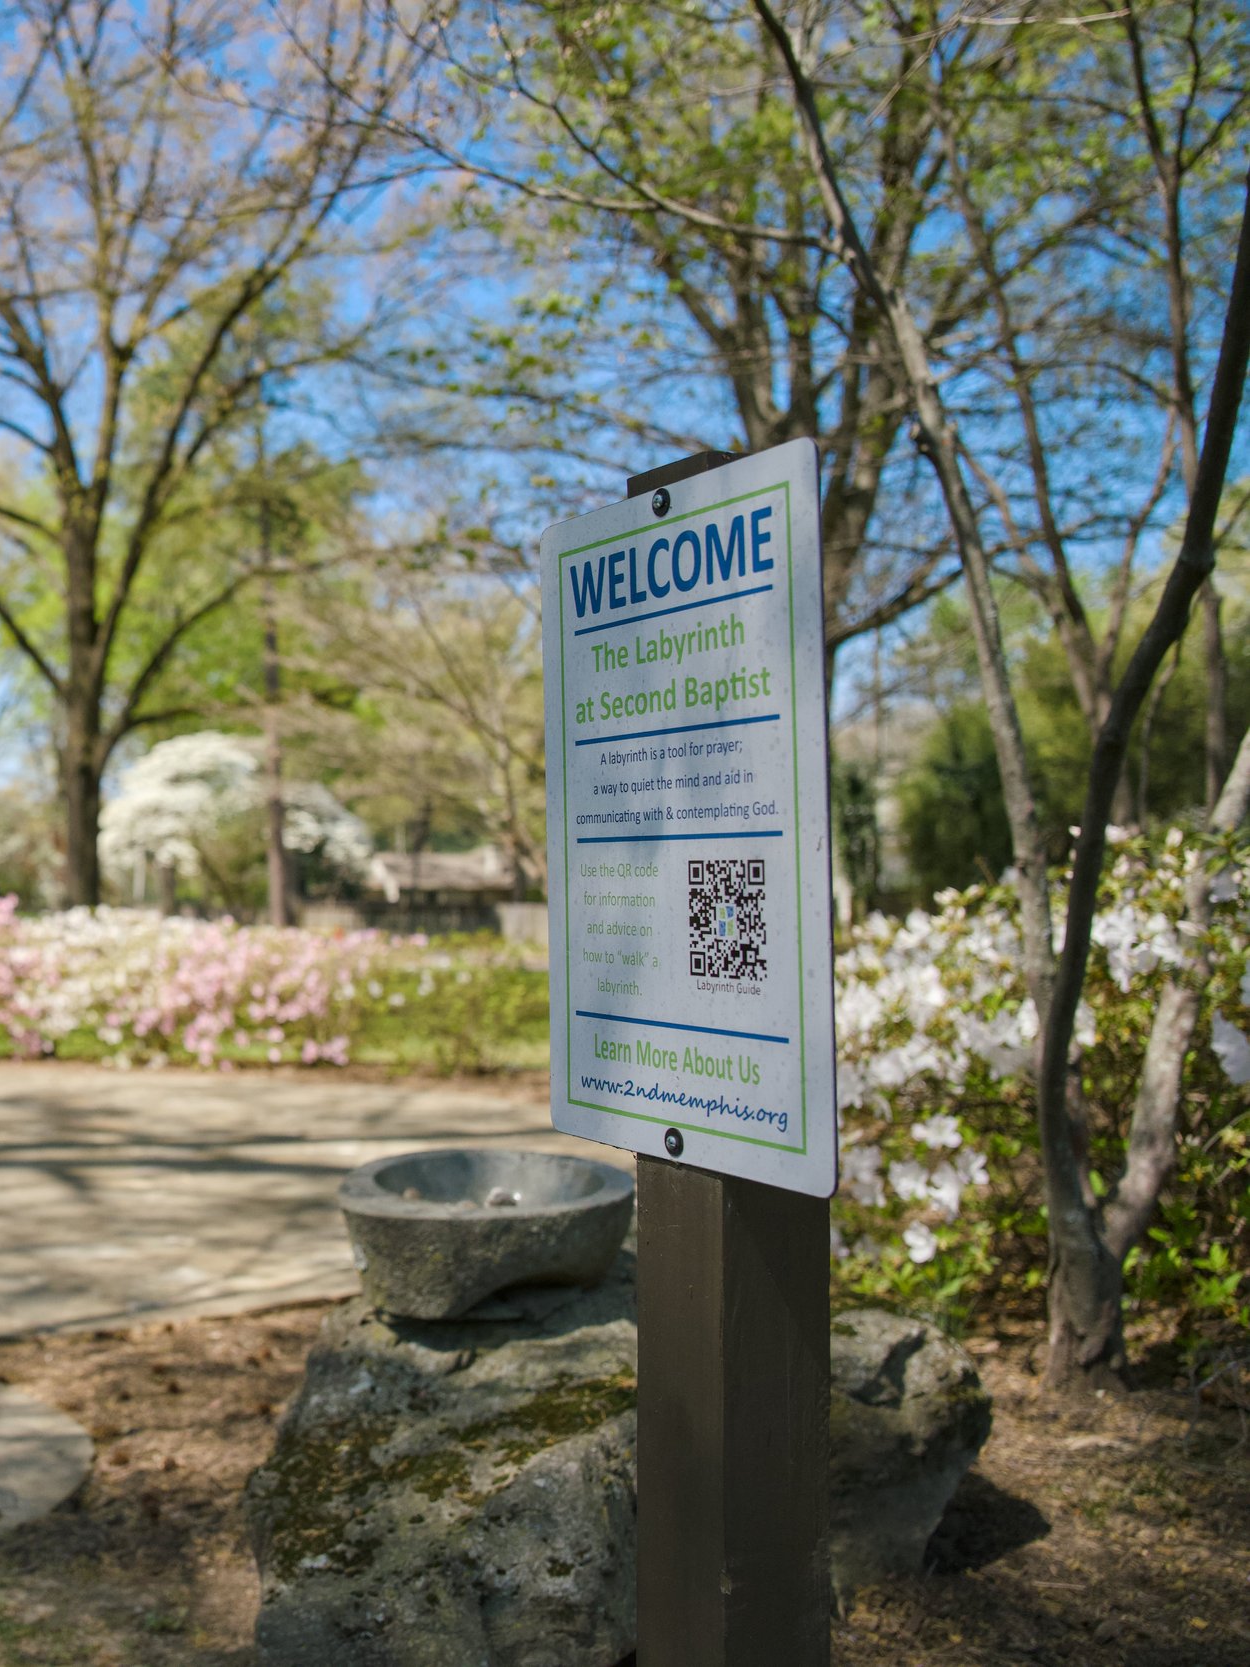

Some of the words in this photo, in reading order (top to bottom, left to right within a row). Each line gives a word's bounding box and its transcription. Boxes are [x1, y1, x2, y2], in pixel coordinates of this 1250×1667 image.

[570, 506, 774, 618] WELCOME
[591, 641, 629, 673] The
[636, 613, 745, 664] Labyrinth
[576, 697, 594, 724] at
[600, 679, 676, 720] Second
[685, 667, 771, 711] Baptist
[600, 752, 607, 765] A
[608, 748, 648, 766] labyrinth
[650, 747, 657, 760] is
[660, 749, 665, 760] a
[667, 743, 687, 759] tool
[689, 742, 703, 757] for
[706, 740, 743, 758] prayer;
[593, 785, 599, 795] a
[600, 783, 618, 797] way
[620, 781, 629, 794] to
[631, 778, 655, 796] quiet
[657, 776, 673, 791] the
[675, 773, 700, 789] mind
[702, 771, 722, 787] and
[724, 770, 741, 785] aid
[743, 770, 753, 784] in
[576, 809, 641, 825] communicating
[643, 806, 664, 822] with
[666, 806, 674, 820] &
[676, 802, 750, 822] contemplating
[752, 800, 779, 816] God.
[580, 863, 598, 878] Use
[599, 862, 615, 878] the
[617, 863, 632, 880] QR
[634, 862, 659, 878] code
[583, 891, 598, 906] for
[599, 892, 656, 907] information
[587, 920, 604, 935] and
[606, 921, 638, 937] advice
[640, 924, 653, 937] on
[583, 948, 602, 963] how
[604, 951, 615, 965] to
[652, 957, 658, 968] a
[597, 977, 643, 998] labyrinth.
[696, 976, 735, 994] Labyrinth
[736, 982, 761, 996] Guide
[594, 1033, 631, 1064] Learn
[636, 1039, 678, 1071] More
[682, 1046, 734, 1081] About
[738, 1055, 761, 1085] Us
[581, 1075, 788, 1133] www.2ndmemphis.org
